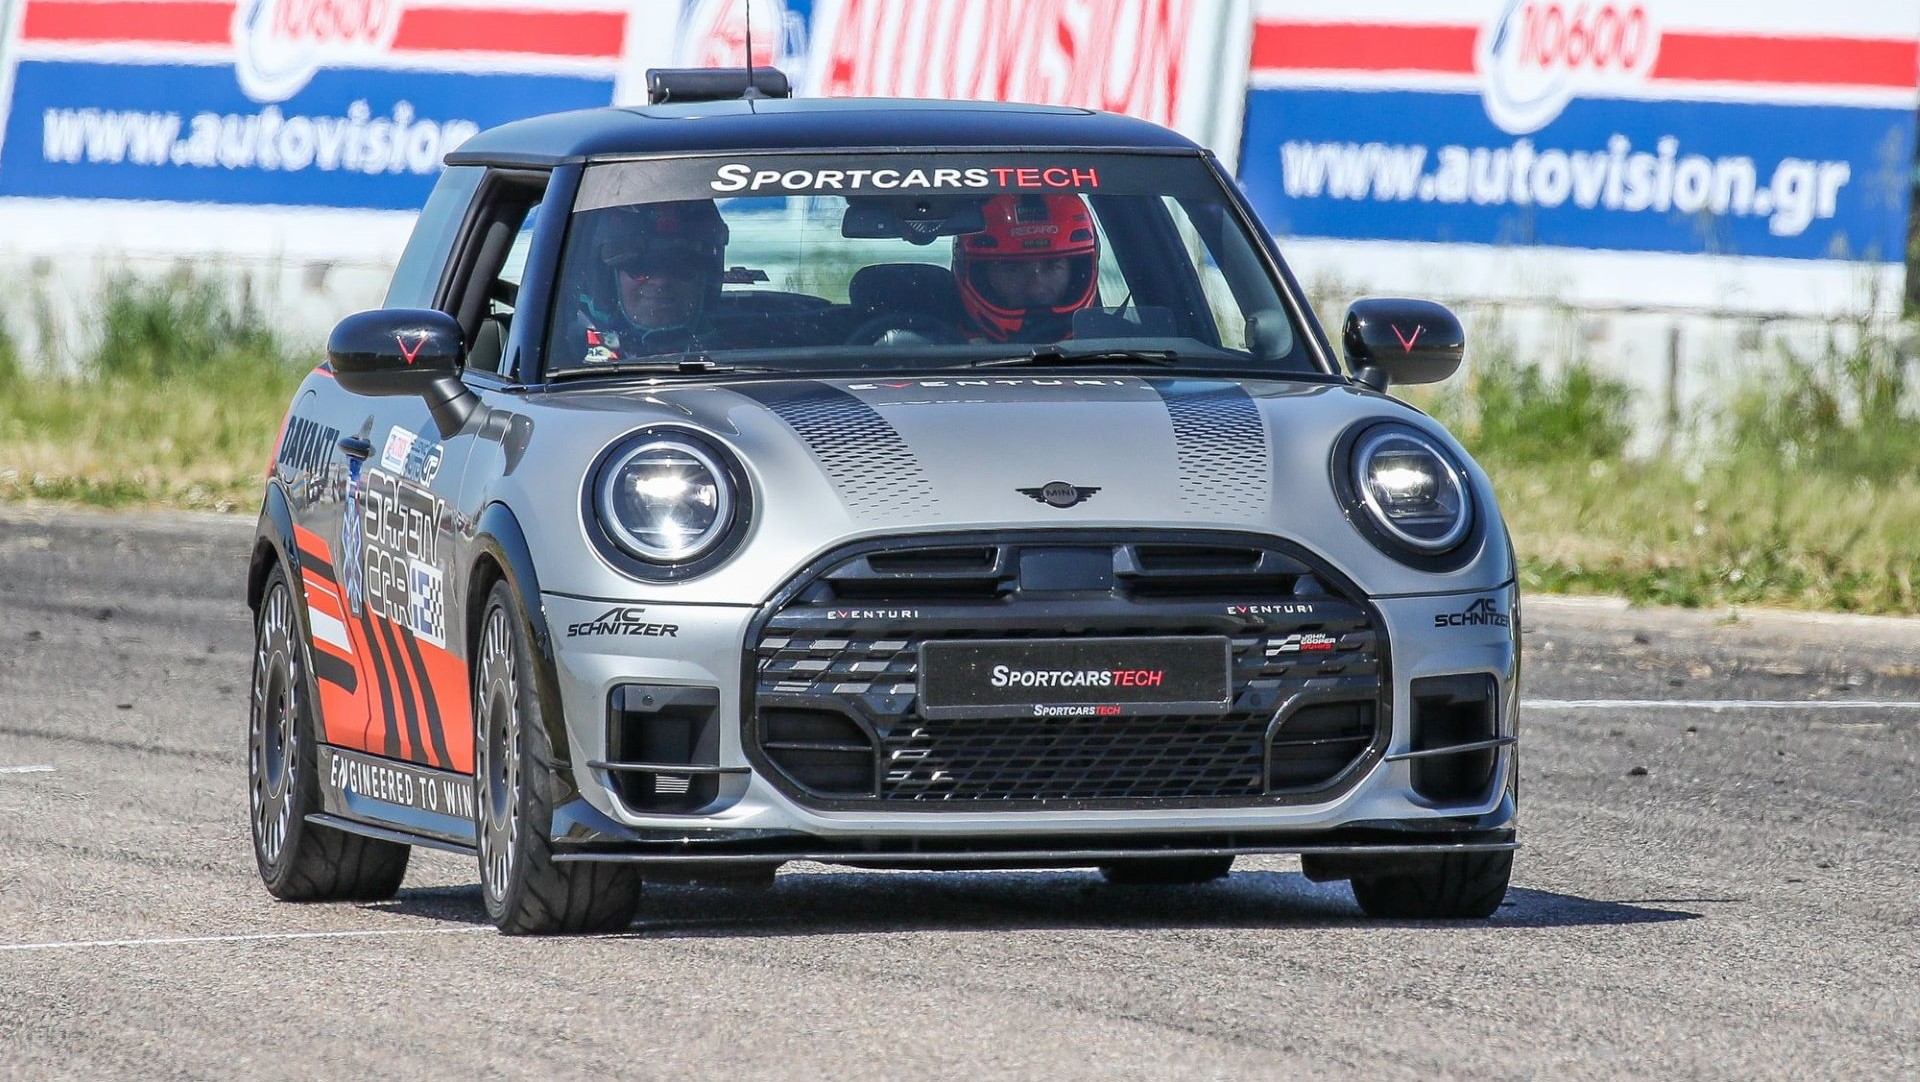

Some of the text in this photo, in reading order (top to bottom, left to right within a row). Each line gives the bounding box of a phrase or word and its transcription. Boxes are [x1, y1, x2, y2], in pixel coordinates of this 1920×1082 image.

[1518, 3, 1650, 70] 10600
[1279, 133, 1852, 237] www.autovision.gr
[847, 378, 1125, 391] EVENTURI
[279, 414, 341, 479] DAVANTI
[594, 607, 646, 622] AC
[826, 609, 920, 620] EVENTURI
[1226, 604, 1314, 615] EVENTURI
[566, 621, 679, 638] SCHNITZER
[330, 754, 474, 818] ENGINEERED TO WIN
